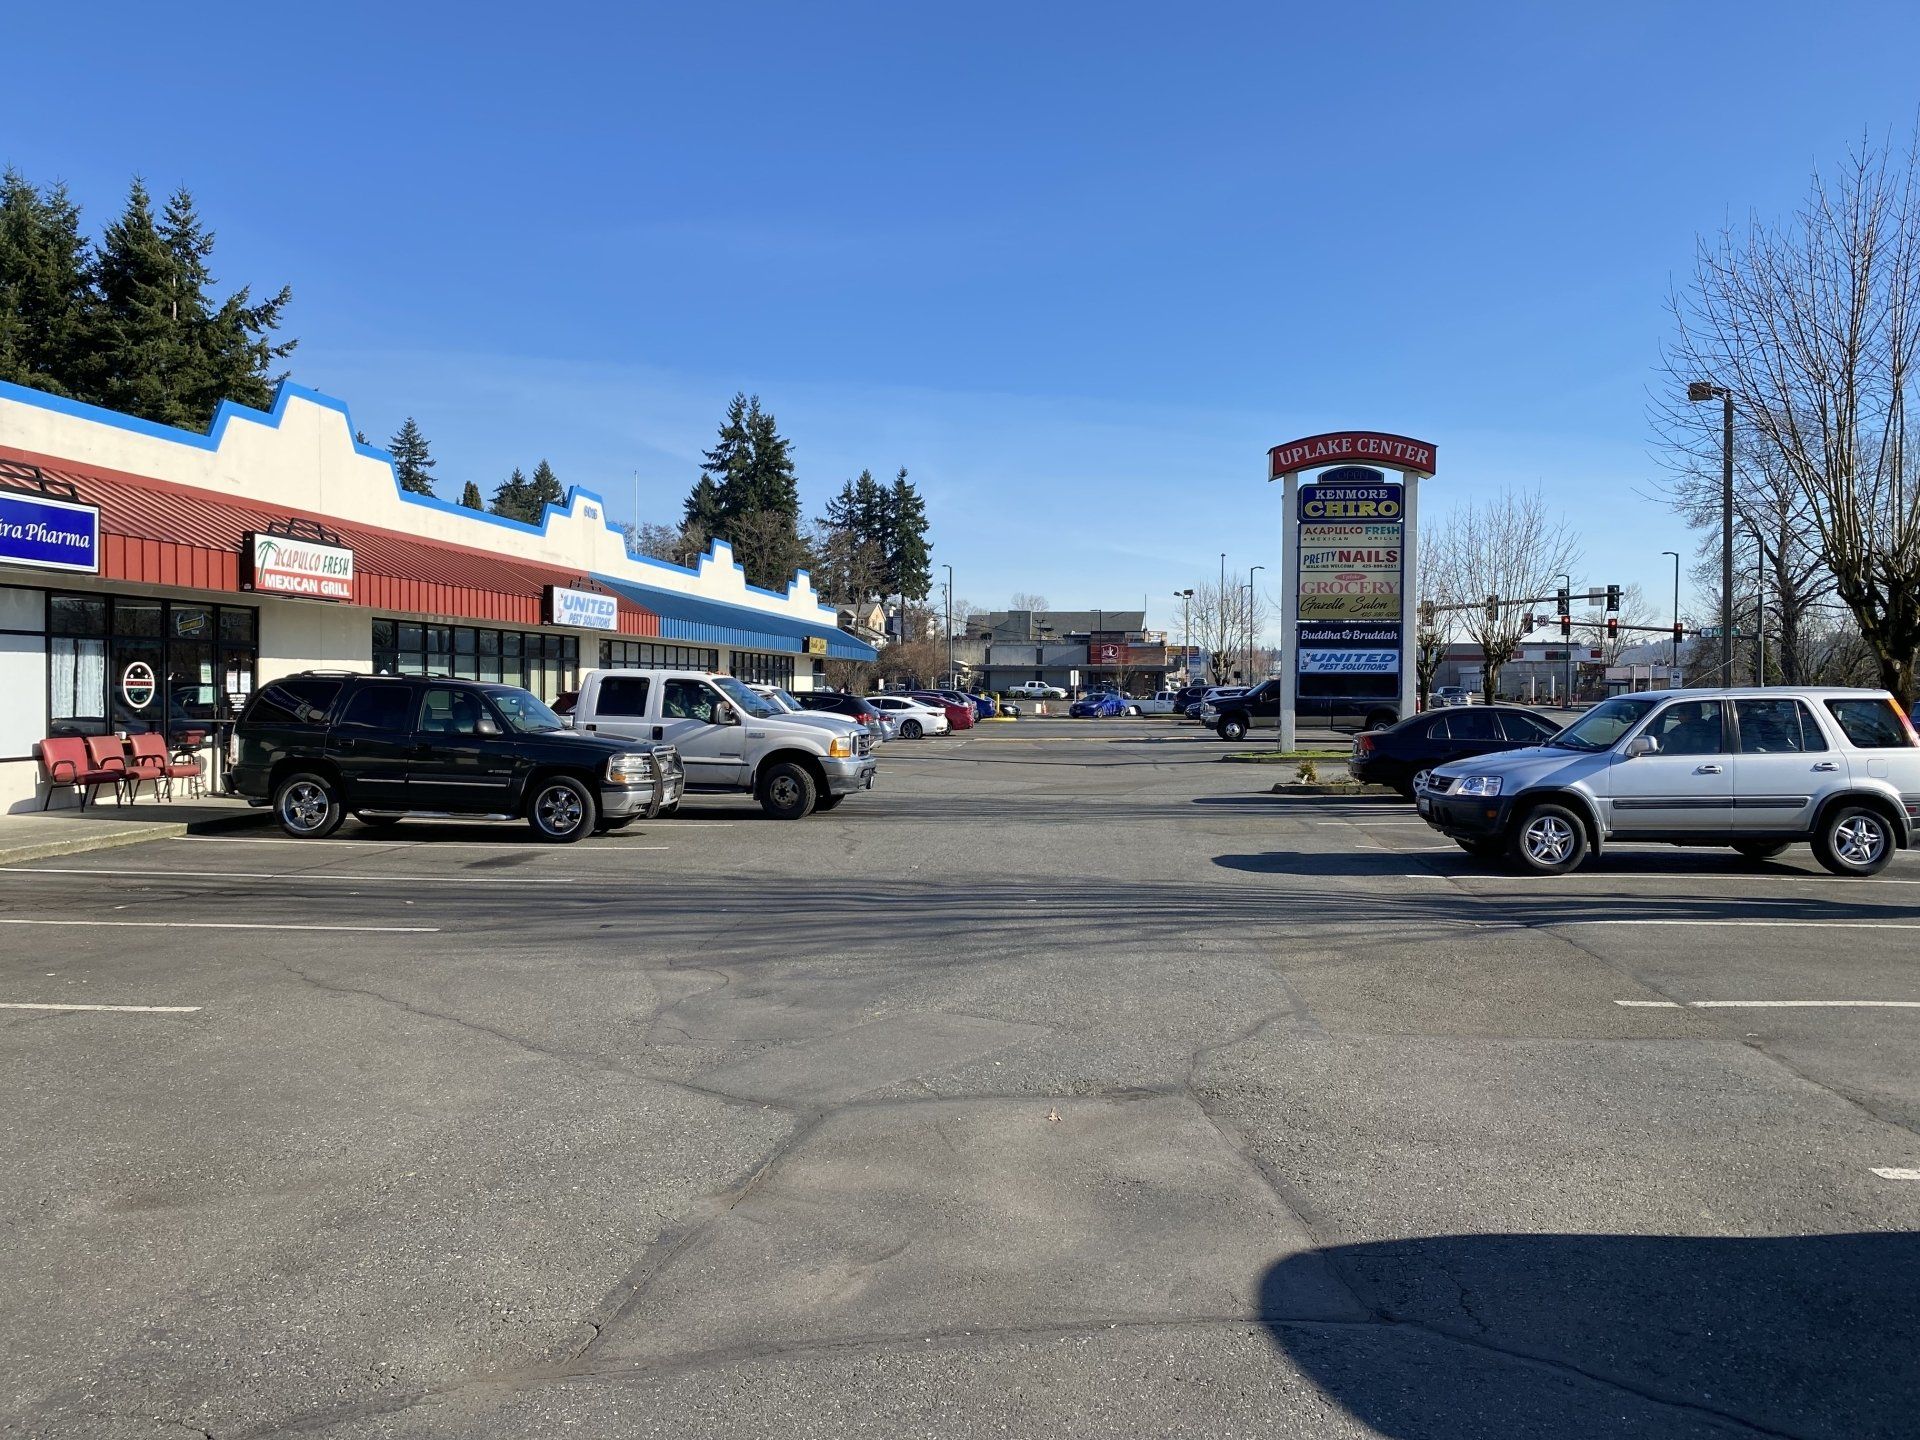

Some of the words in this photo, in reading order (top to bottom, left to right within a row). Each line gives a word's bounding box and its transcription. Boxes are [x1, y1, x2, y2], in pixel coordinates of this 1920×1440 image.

[1278, 438, 1352, 465] UPLAKE
[1357, 438, 1429, 464] CENTER
[1315, 489, 1388, 499] KENMORE
[1304, 500, 1399, 517] CHIRO
[25, 522, 91, 548] Pharma
[1304, 526, 1363, 535] ACAPULCO
[1364, 526, 1400, 535] FRESH
[274, 548, 320, 571] ACAPULCO
[322, 555, 350, 576] FRESH
[1303, 551, 1337, 565] PRETTY
[1338, 550, 1398, 563] NAILS
[264, 573, 318, 593] MEXICAN
[320, 580, 350, 597] GRILL
[1301, 581, 1398, 594] GROCERY
[563, 594, 615, 616] UNITED
[1300, 595, 1346, 614] Gazelle
[1350, 595, 1388, 613] Salon
[569, 613, 583, 625] PEST
[1301, 630, 1341, 640] Buddha
[1353, 630, 1398, 640] Bruddah
[1311, 653, 1397, 662] UNITED
